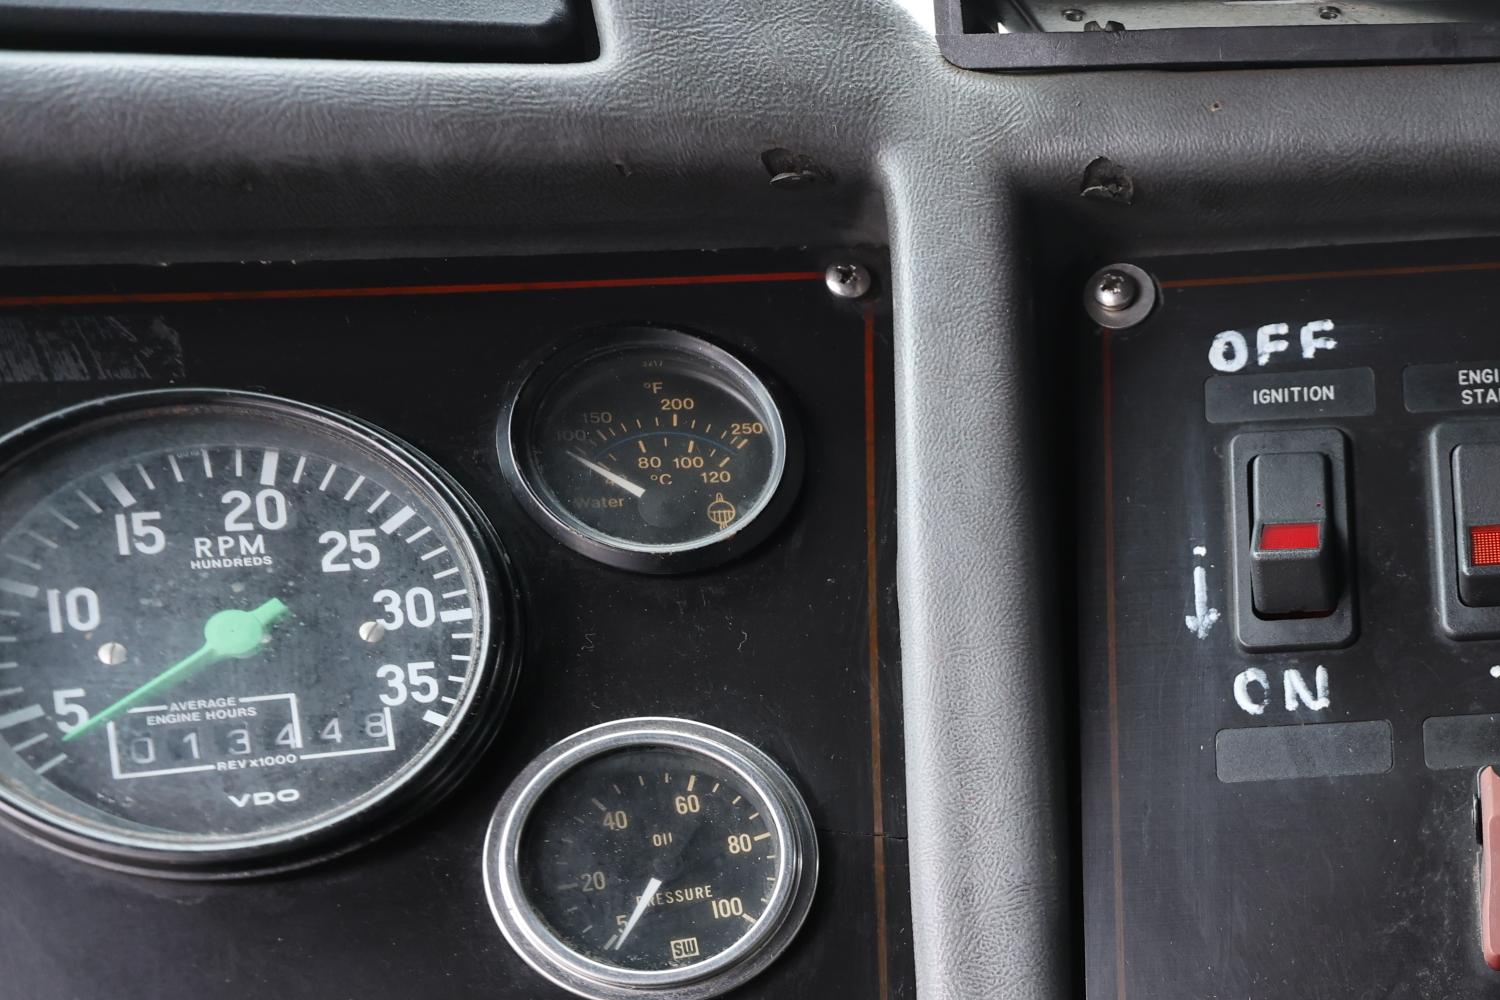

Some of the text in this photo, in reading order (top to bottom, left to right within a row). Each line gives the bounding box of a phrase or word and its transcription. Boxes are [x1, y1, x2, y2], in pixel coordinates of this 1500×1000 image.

[1208, 319, 1338, 373] OFF
[660, 396, 694, 411] 200
[1252, 385, 1336, 405] IGNITION
[730, 420, 764, 436] 250
[638, 455, 662, 470] 80
[672, 455, 704, 470] 100
[700, 470, 731, 485] 120
[221, 489, 288, 532] 20
[576, 494, 624, 510] Water
[115, 511, 166, 556] 15
[193, 534, 267, 560] RPM
[317, 528, 381, 573] 25
[190, 556, 273, 571] HUNDREDS
[47, 587, 100, 634] 10
[373, 587, 436, 630] 30
[376, 661, 439, 707] 35
[1233, 664, 1331, 715] ON
[54, 688, 89, 735] 5
[145, 706, 257, 726] ENGINE HOURS
[169, 697, 237, 712] AVERAGE
[216, 762, 245, 773] REV
[227, 788, 300, 808] VDO
[675, 793, 701, 816] 60
[602, 809, 629, 831] 40
[727, 832, 752, 855] 80
[580, 870, 606, 893] 20
[711, 896, 744, 920] 100
